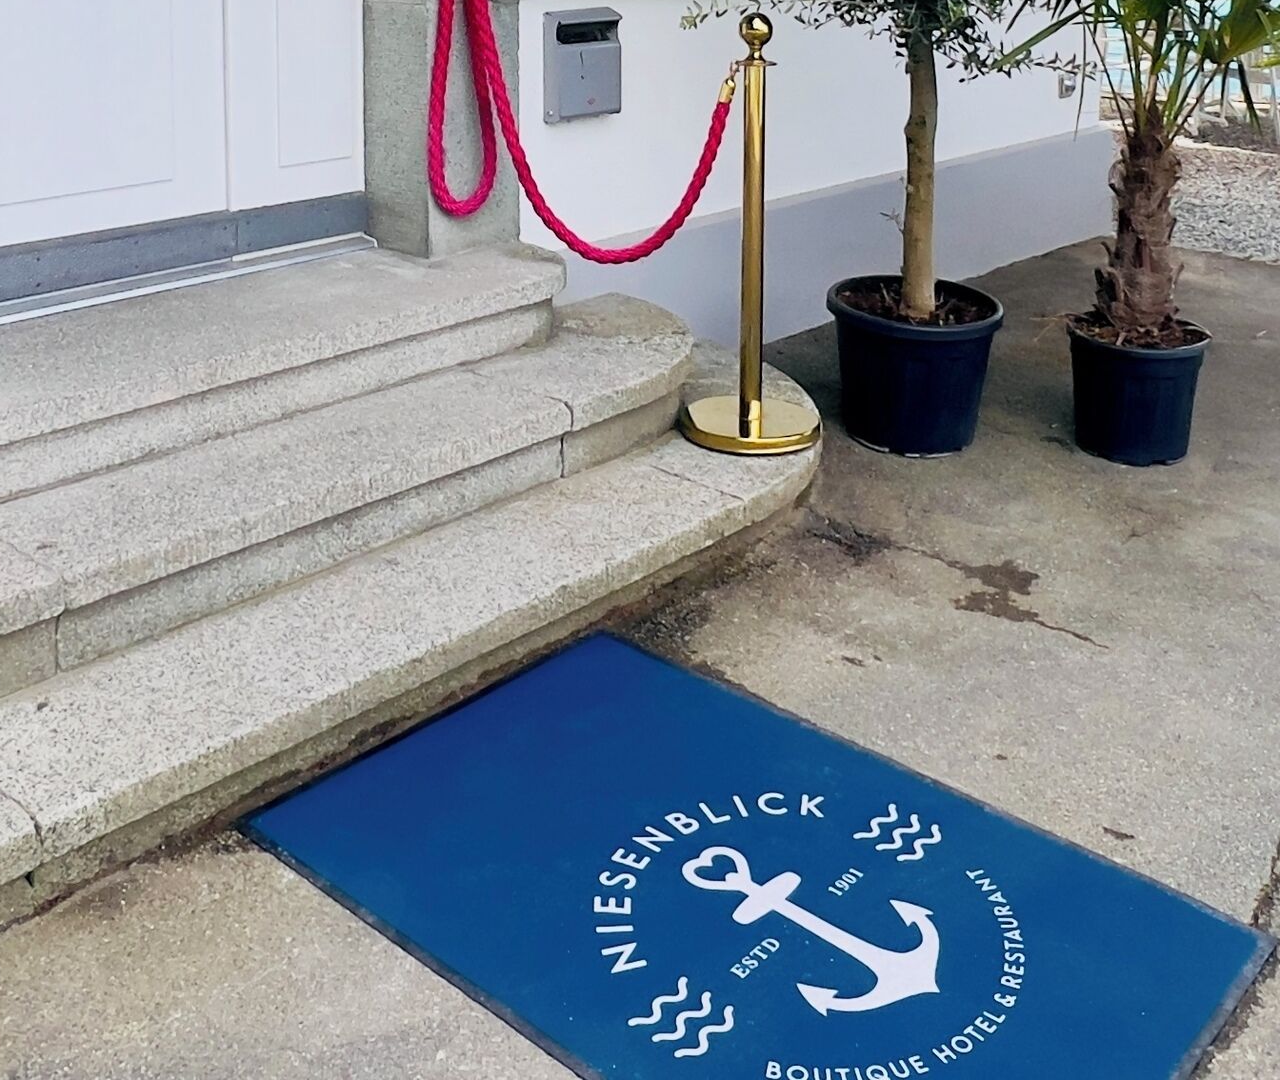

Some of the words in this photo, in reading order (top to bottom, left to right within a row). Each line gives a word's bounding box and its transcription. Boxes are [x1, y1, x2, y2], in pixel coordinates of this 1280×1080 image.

[593, 792, 825, 974] NIESENBLICK
[729, 937, 781, 979] ESTD
[828, 868, 864, 897] 1901
[965, 868, 1026, 990] RESTAURANT
[932, 1010, 1006, 1064] HOTEL
[993, 992, 1017, 1008] &
[765, 1054, 930, 1080] BOUTIQUE
